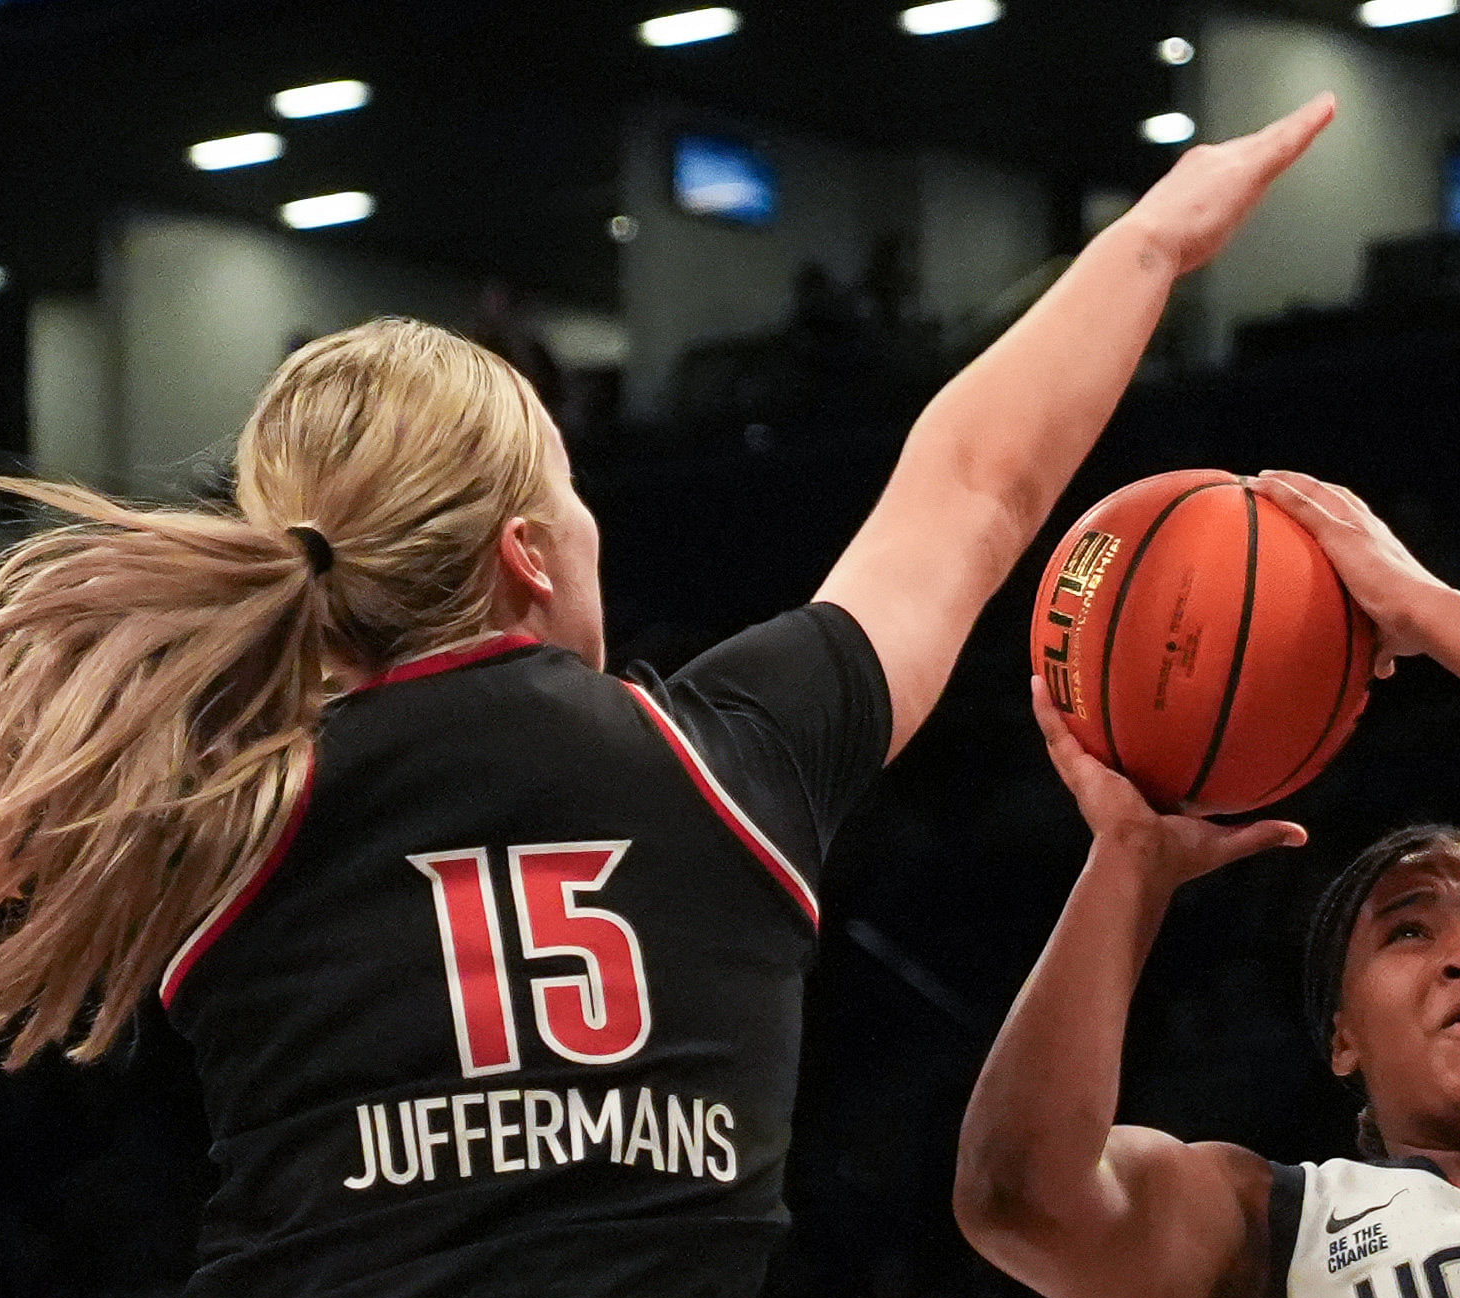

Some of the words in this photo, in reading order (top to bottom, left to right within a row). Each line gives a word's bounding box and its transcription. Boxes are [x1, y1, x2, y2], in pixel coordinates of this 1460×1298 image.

[406, 840, 652, 1079] 15
[343, 1087, 737, 1191] JUFFERMANS
[1328, 1235, 1389, 1274] CHANGE
[1329, 1236, 1348, 1256] BE
[1353, 1222, 1383, 1244] THE
